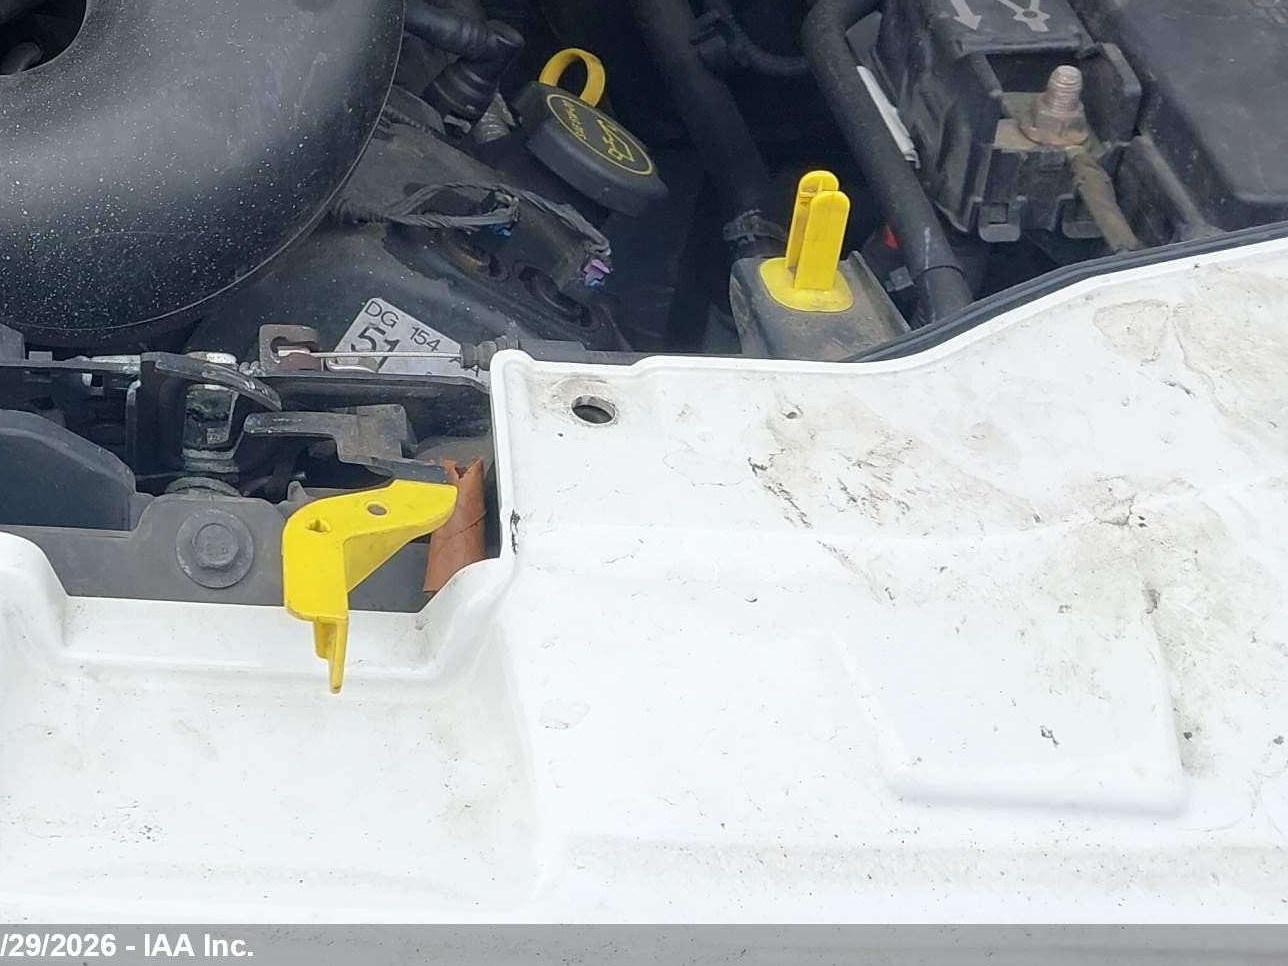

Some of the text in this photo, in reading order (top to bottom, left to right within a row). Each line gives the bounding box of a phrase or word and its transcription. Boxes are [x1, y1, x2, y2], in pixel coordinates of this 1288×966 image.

[350, 324, 401, 372] 51
[364, 300, 399, 329] DG
[410, 326, 441, 352] 154
